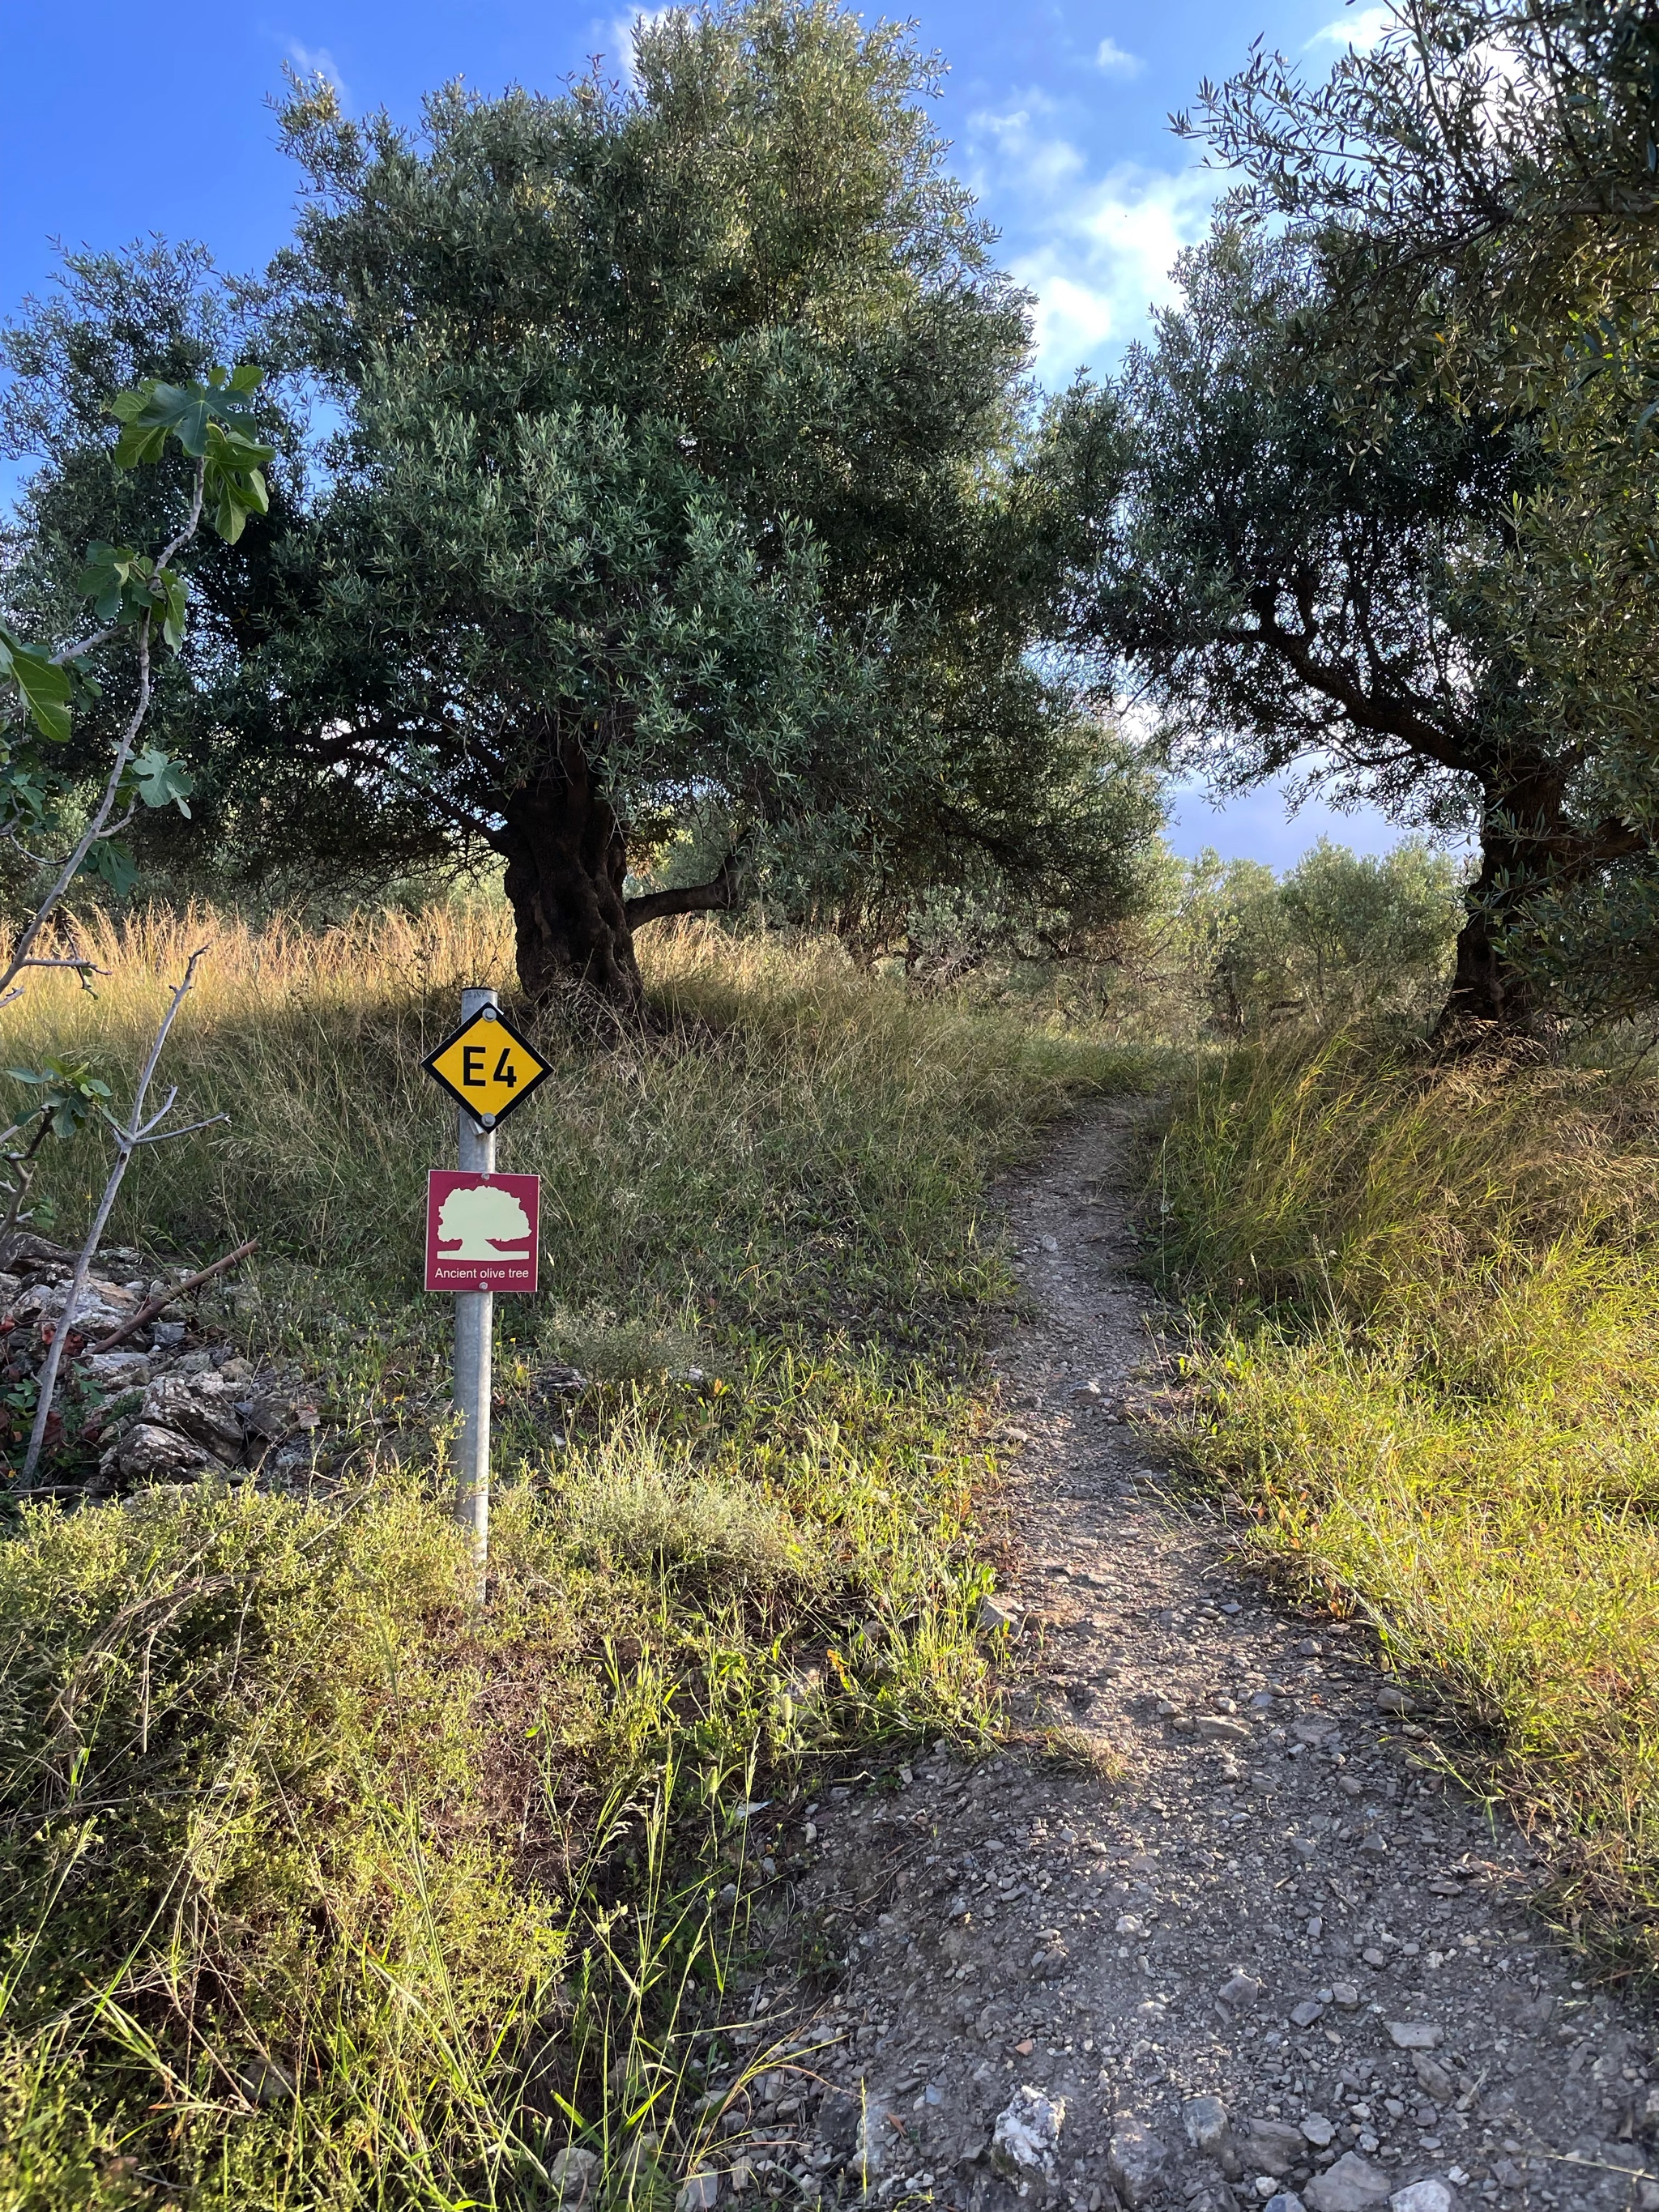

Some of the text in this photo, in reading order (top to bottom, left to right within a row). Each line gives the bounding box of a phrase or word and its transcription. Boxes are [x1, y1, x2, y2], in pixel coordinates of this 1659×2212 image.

[463, 1046, 517, 1088] E4
[434, 1268, 529, 1278] Ancient olive tree
